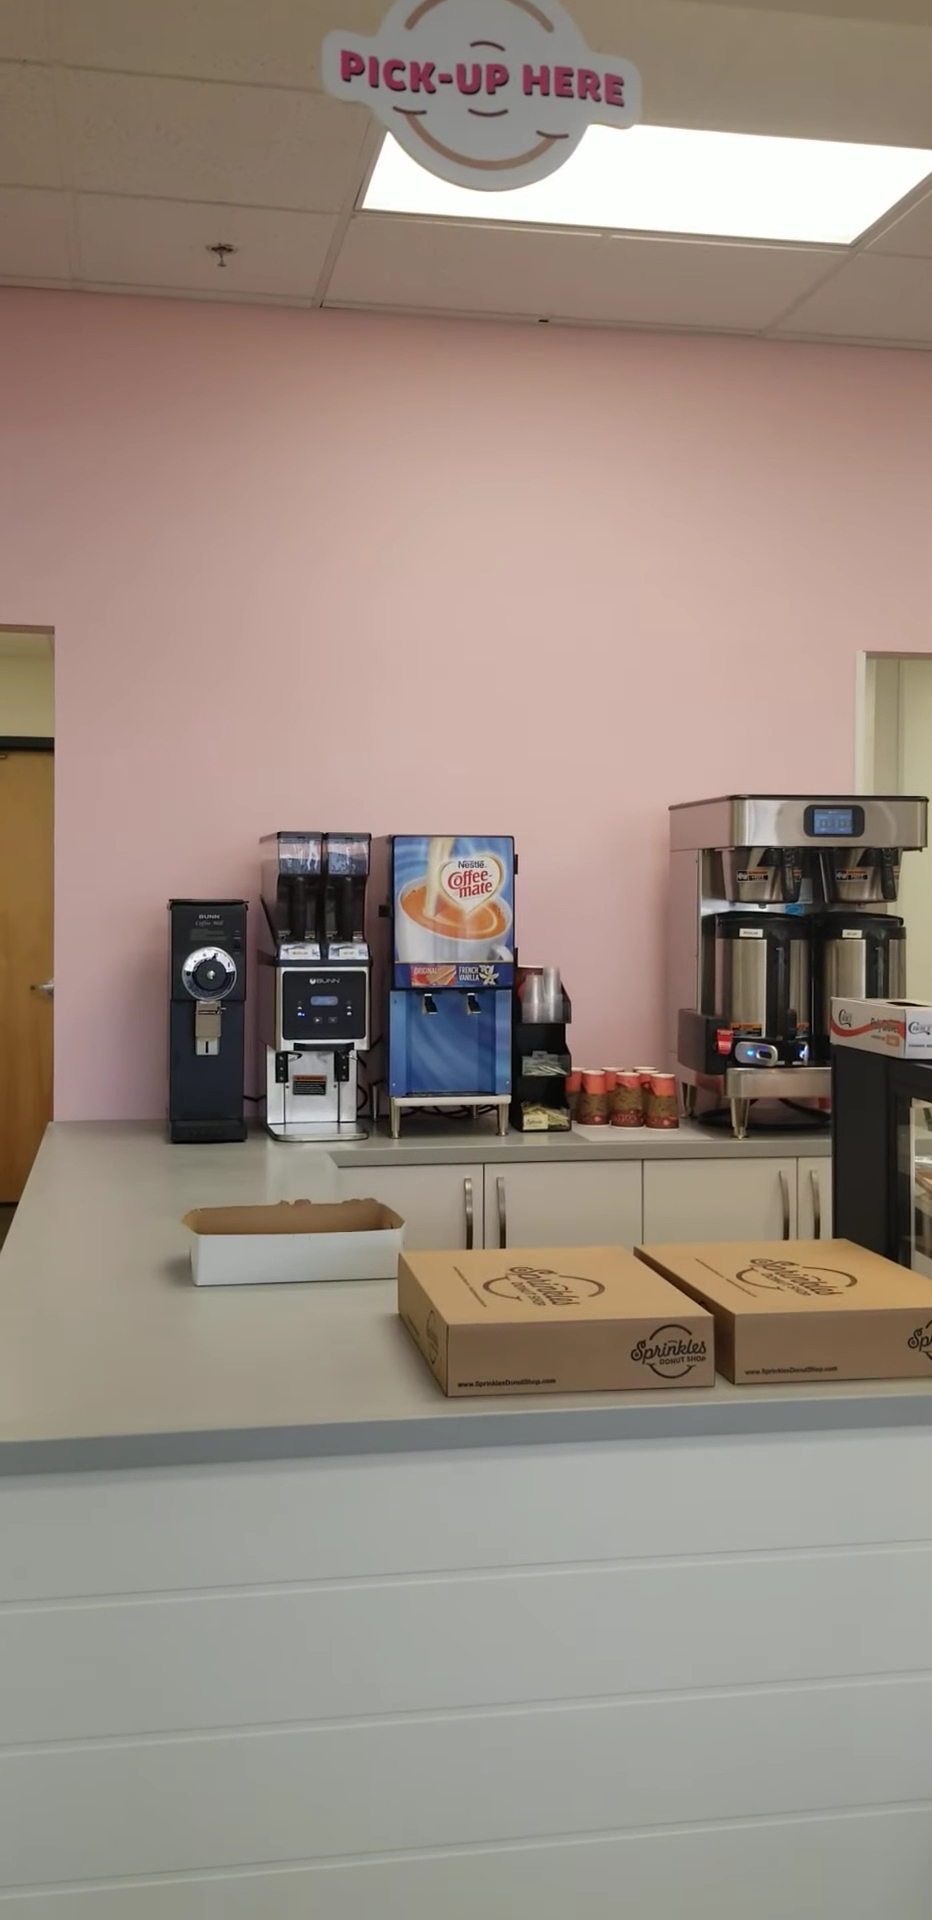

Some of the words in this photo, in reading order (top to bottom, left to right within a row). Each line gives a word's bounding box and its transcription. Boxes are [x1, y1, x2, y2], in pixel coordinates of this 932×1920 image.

[340, 49, 509, 96] PICK-UP
[522, 64, 625, 107] HERE
[458, 860, 485, 869] Nestlé
[459, 881, 493, 899] mate
[413, 966, 439, 975] ORIGINAL
[458, 966, 479, 974] FRENCH
[459, 974, 480, 982] VANILLA
[907, 1327, 932, 1352] Sp
[630, 1339, 707, 1365] Sprinkles
[659, 1356, 686, 1365] DONUT
[687, 1355, 707, 1363] SHOP
